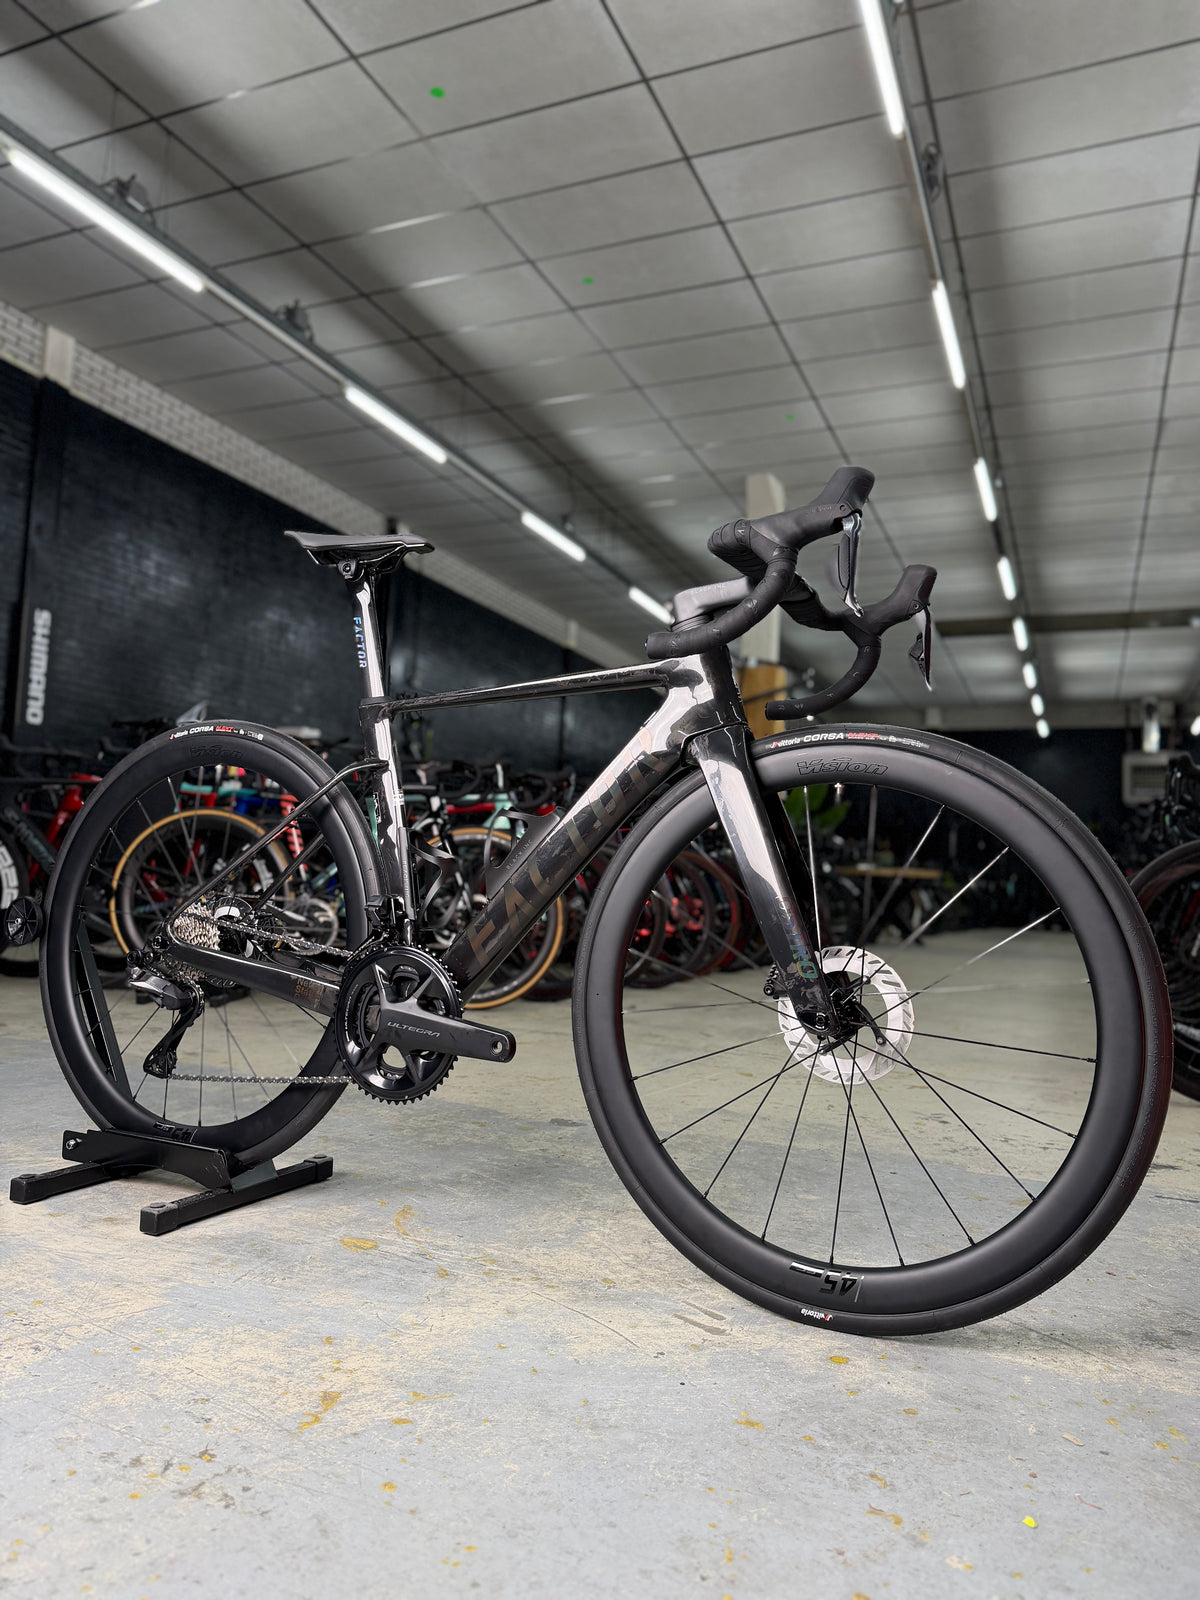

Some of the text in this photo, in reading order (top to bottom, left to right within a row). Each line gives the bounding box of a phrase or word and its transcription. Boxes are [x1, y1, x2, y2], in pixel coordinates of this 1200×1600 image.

[353, 616, 368, 669] FACTOR
[25, 607, 52, 726] SHIMANO
[803, 732, 844, 742] CORSA
[797, 757, 889, 776] Vision
[463, 728, 668, 968] FACTOR
[387, 1021, 441, 1038] ULTEGRA
[819, 1271, 858, 1296] 45
[801, 1308, 826, 1320] vittoria
